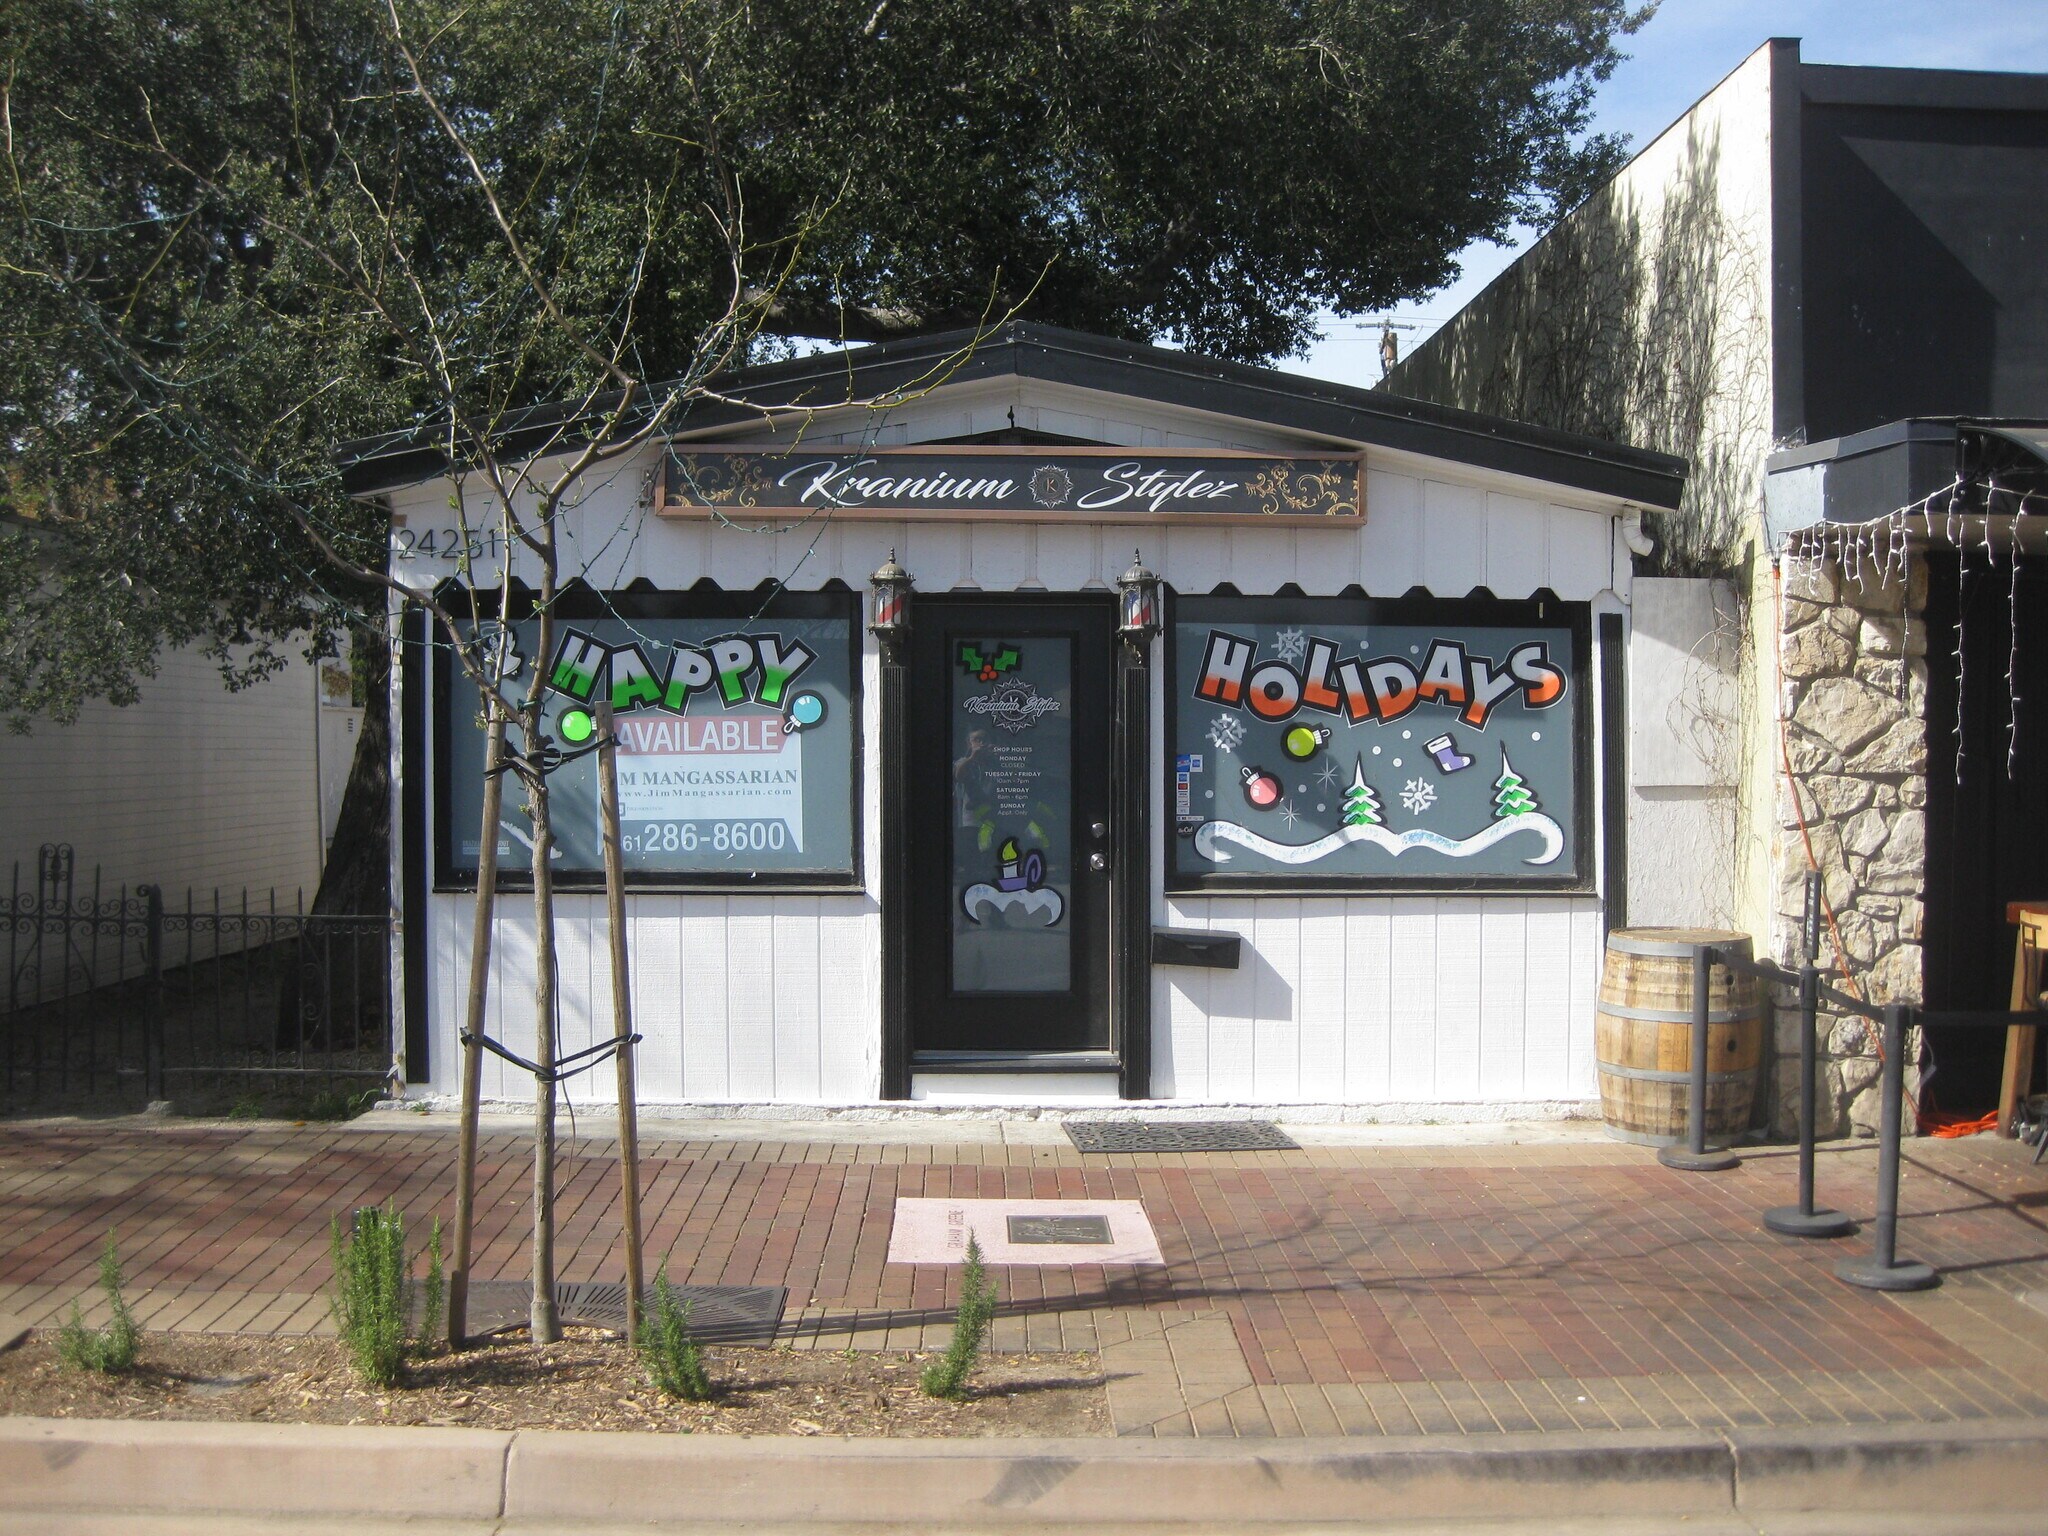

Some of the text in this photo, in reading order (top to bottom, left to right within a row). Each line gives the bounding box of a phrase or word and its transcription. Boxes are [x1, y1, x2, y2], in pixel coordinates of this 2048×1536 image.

[778, 459, 1239, 512] Kranium Stylez
[399, 528, 496, 559] 24251
[548, 629, 817, 715] HAPPY
[1195, 631, 1566, 729] HOLIDAYS
[963, 695, 1020, 714] Kranium
[616, 720, 779, 753] AVAILABLE
[617, 787, 792, 798] ww.JimMangassarian.com
[642, 769, 798, 786] MANGASSARIAN
[644, 822, 785, 852] 286-8600
